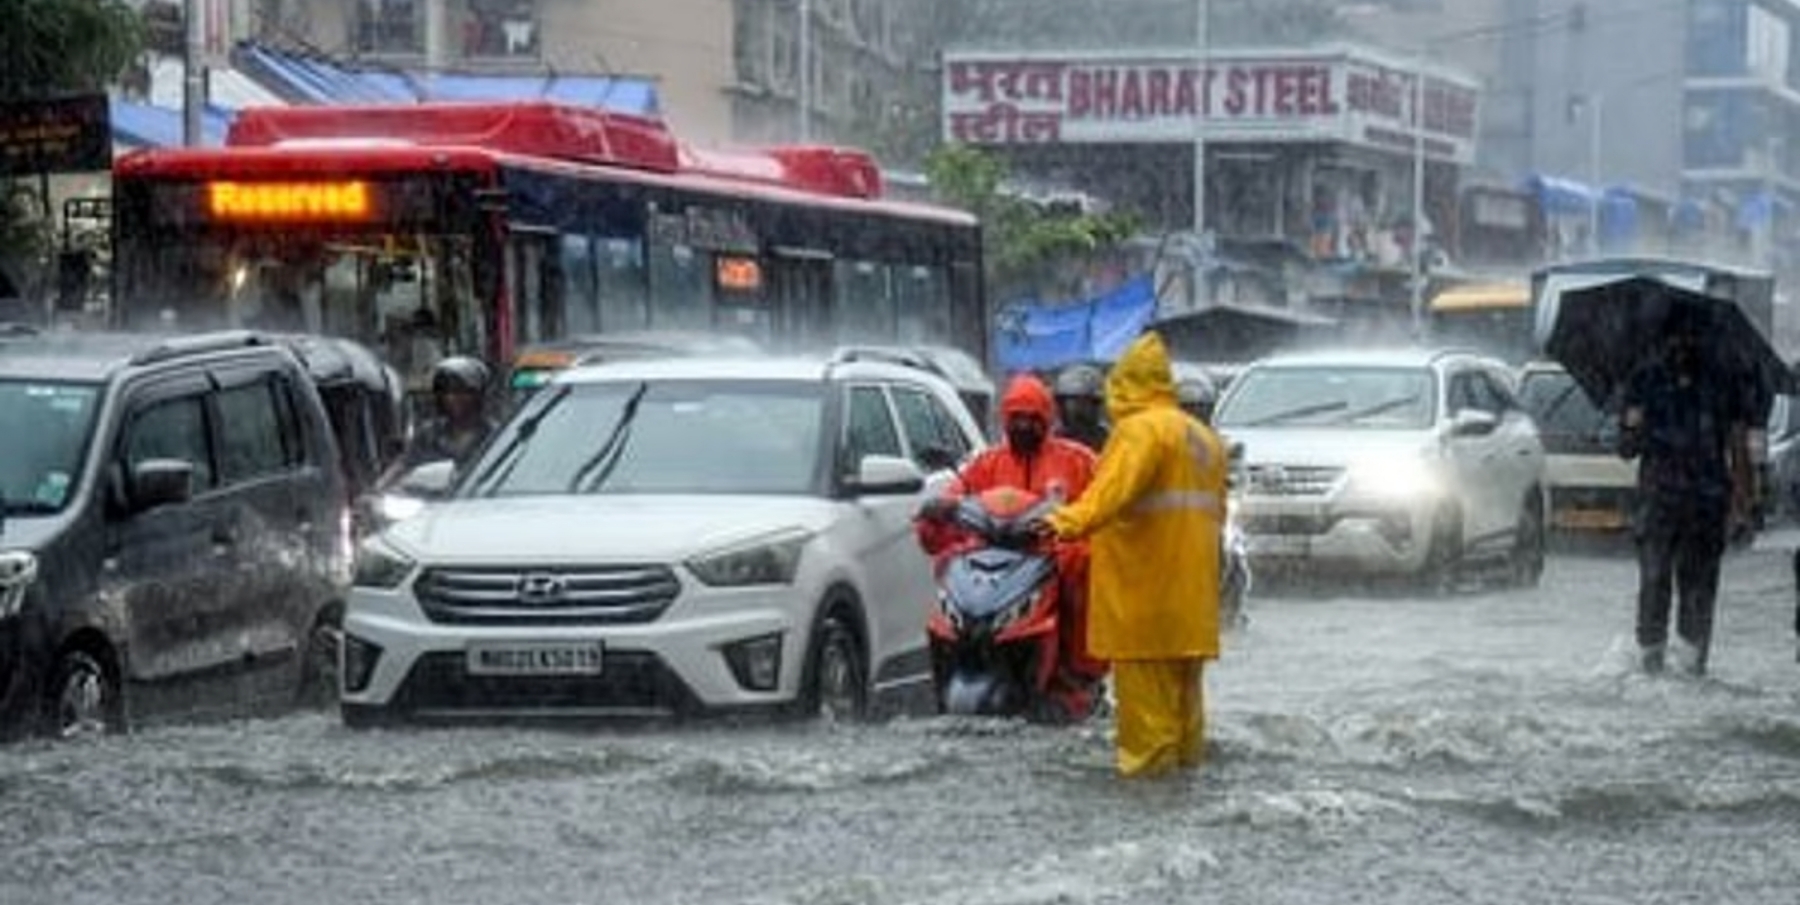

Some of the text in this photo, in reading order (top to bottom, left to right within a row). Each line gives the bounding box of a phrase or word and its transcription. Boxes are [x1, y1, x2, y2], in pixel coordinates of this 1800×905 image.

[1068, 68, 1218, 118] BHARAT
[1223, 66, 1340, 117] STEEL
[211, 181, 367, 215] Reserved
